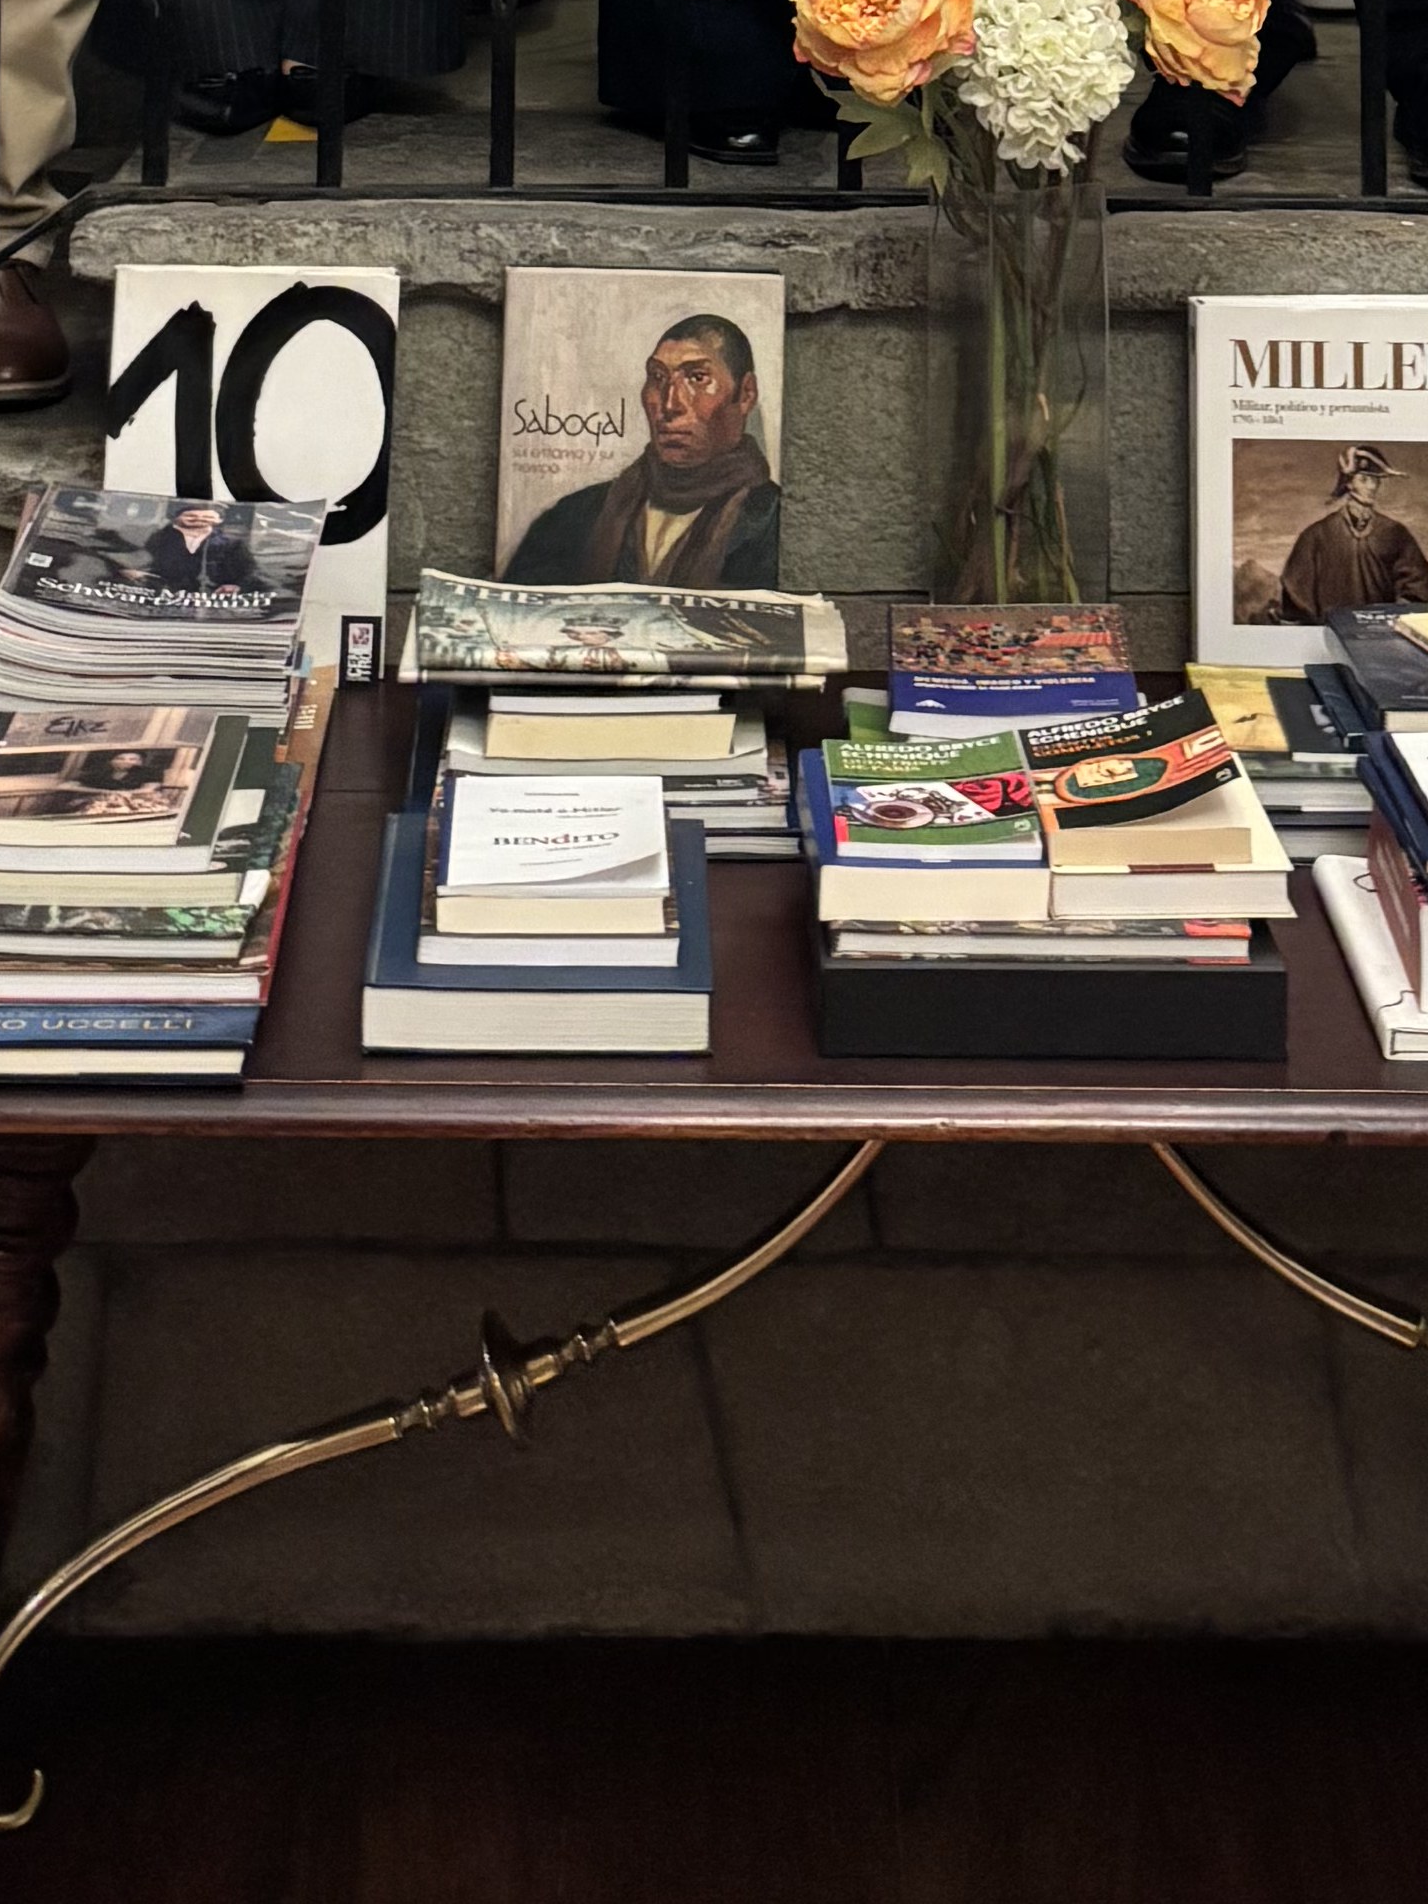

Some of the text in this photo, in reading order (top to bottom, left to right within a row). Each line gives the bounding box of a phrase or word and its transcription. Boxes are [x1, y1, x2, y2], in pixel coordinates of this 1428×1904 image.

[105, 280, 397, 546] 10
[512, 393, 625, 448] Sabogal
[448, 582, 796, 618] THE TIMES
[1027, 695, 1185, 739] ALFREDO BRYCE
[1028, 716, 1149, 746] ECHENIQUE
[839, 736, 1001, 754] ALFREDO BRYCE
[840, 750, 961, 761] ECHENIQUE
[41, 1017, 195, 1032] UCCELLI
